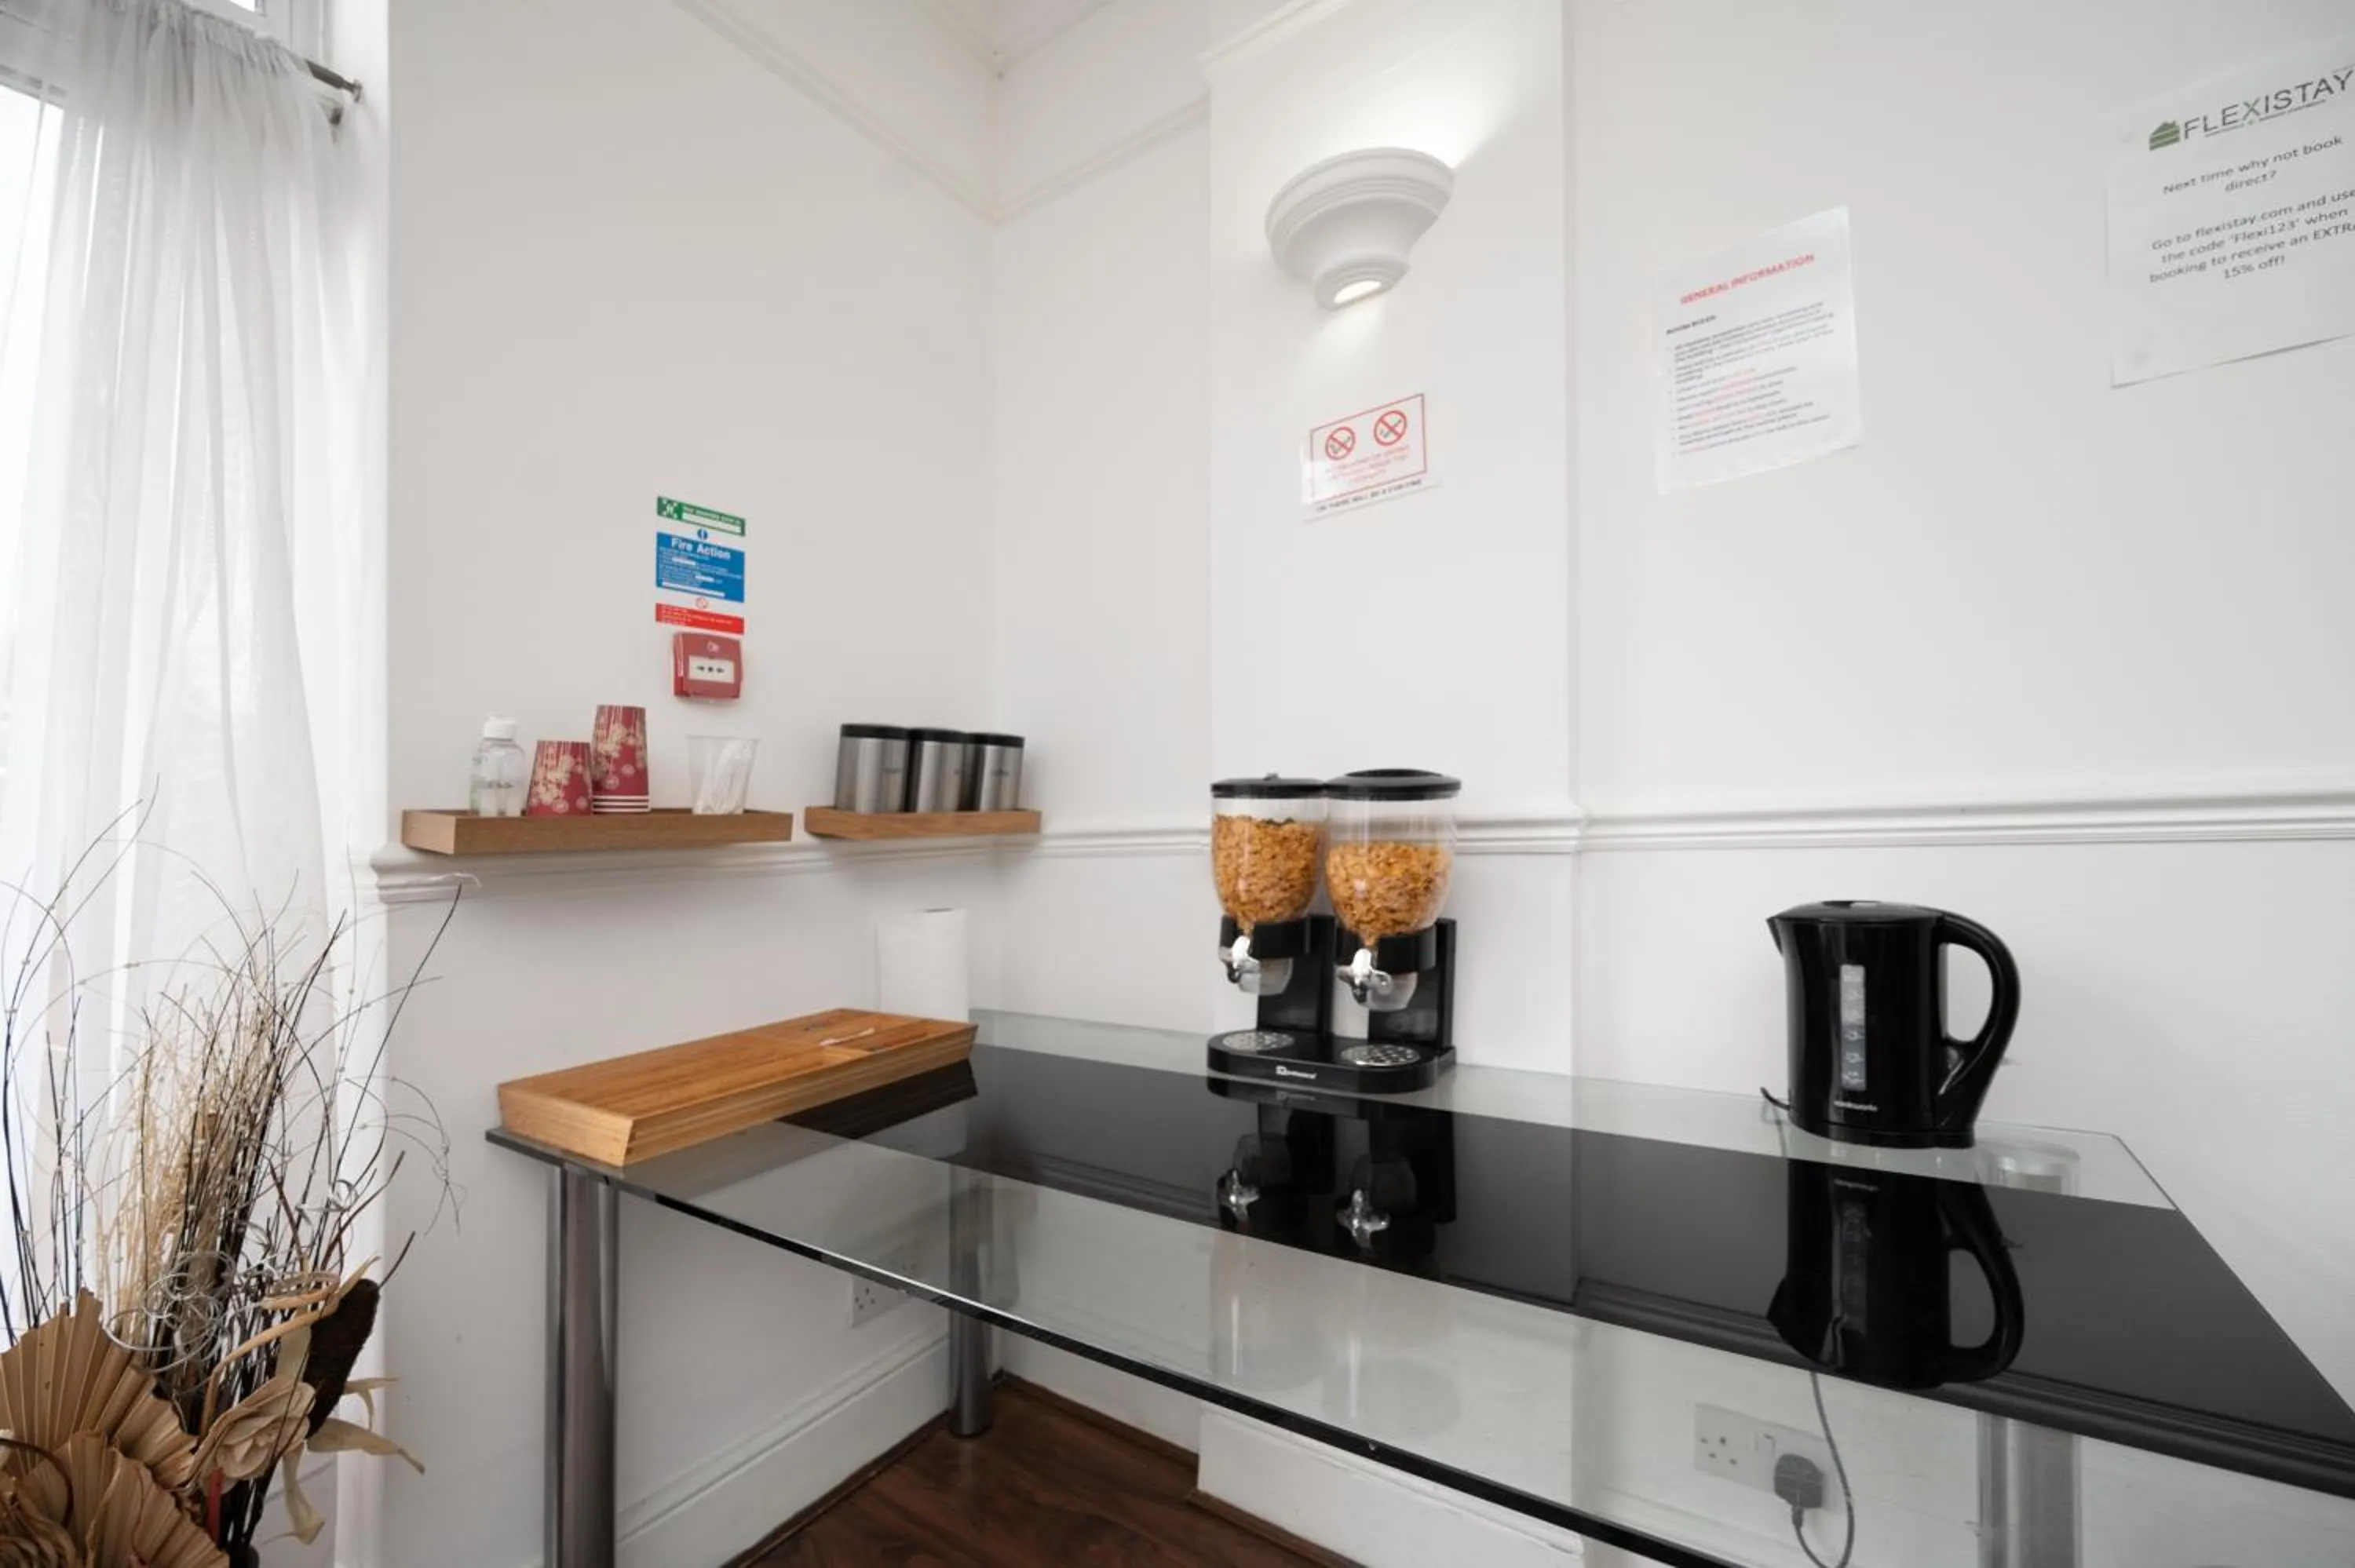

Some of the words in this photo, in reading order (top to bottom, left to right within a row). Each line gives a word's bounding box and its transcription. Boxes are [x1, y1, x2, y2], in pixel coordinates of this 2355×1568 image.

[2184, 69, 2354, 140] FLEXISTAY
[2163, 177, 2196, 195] Next
[2200, 167, 2234, 183] time
[2238, 157, 2269, 173] why
[2273, 148, 2299, 162] not
[2302, 136, 2343, 155] book
[2225, 169, 2277, 192] direct?
[2152, 239, 2173, 250] Go
[2176, 232, 2192, 244] to
[2297, 195, 2328, 212] and
[2161, 250, 2185, 264] the
[2189, 239, 2225, 257] code
[2304, 208, 2350, 226] when
[1731, 253, 1815, 289] INFORMATION
[2149, 261, 2207, 283] booking
[2211, 254, 2227, 266] to
[2231, 239, 2286, 261] receive
[2289, 235, 2309, 246] an
[2313, 223, 2355, 241] EXTR
[2223, 264, 2255, 279] 15%
[671, 538, 693, 552] Fire
[696, 542, 732, 560] Action
